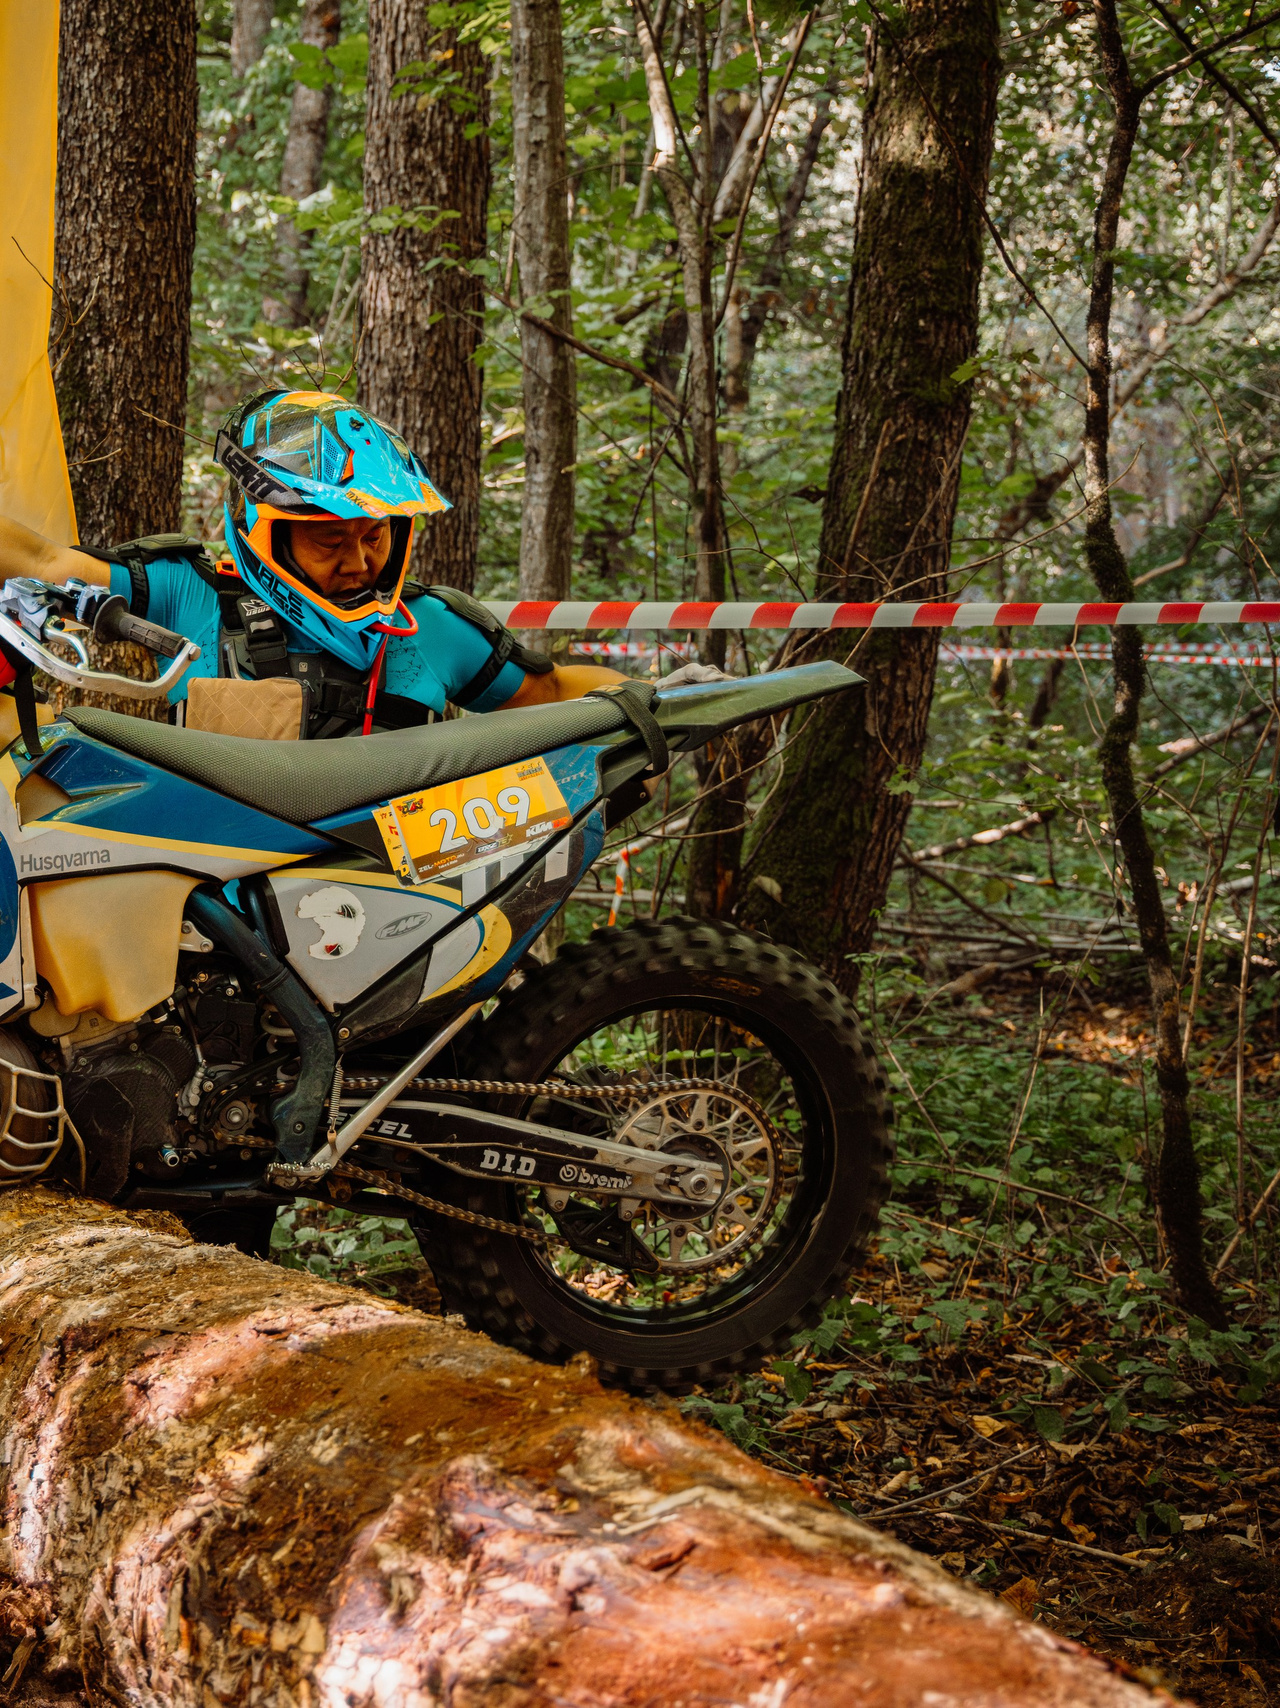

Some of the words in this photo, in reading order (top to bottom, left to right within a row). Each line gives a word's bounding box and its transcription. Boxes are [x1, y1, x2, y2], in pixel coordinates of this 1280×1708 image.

[428, 786, 531, 854] 209
[20, 848, 111, 873] Husqvarna
[379, 914, 430, 938] FMF
[327, 1111, 413, 1139] ECEL
